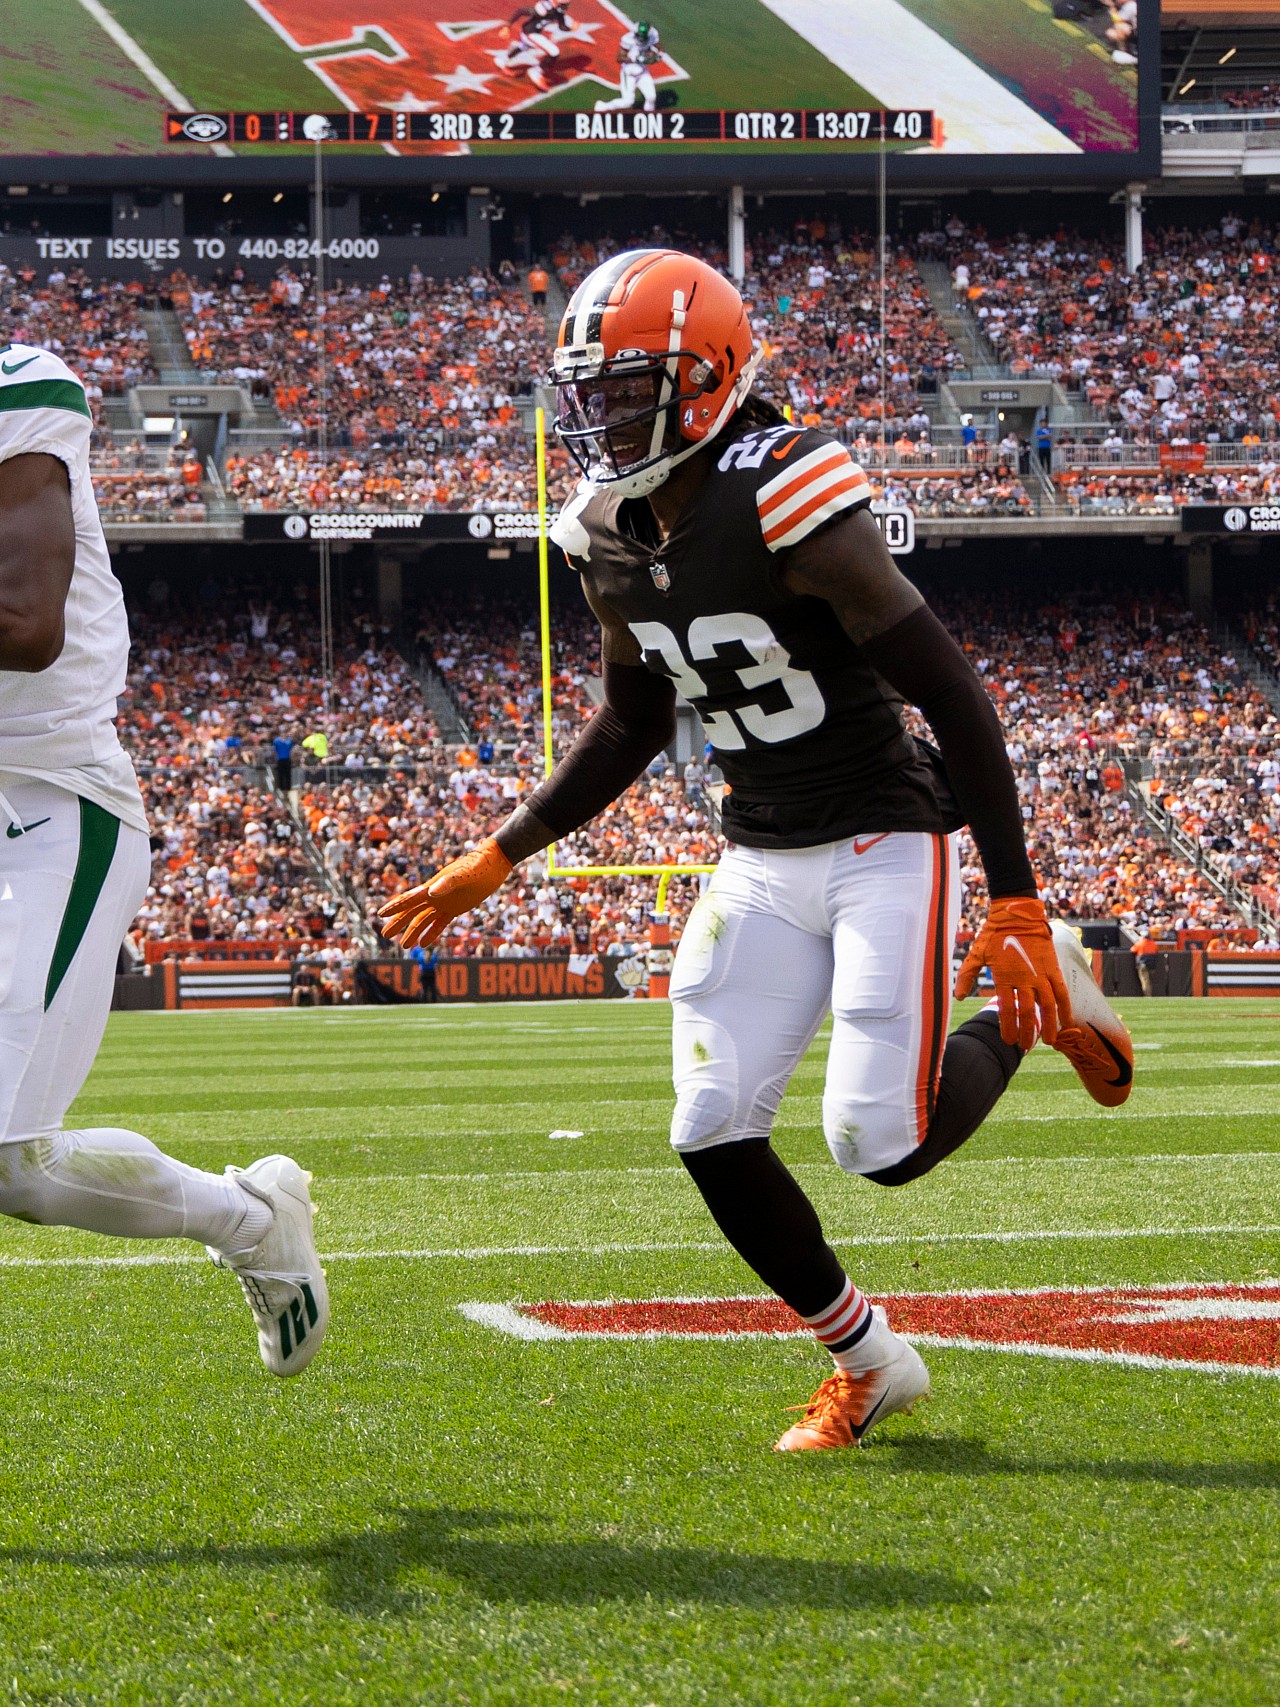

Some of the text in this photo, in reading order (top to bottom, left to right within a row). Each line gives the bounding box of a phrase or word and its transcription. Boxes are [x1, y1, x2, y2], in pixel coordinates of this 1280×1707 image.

[245, 115, 260, 139] 0
[366, 116, 379, 138] 7
[429, 114, 514, 140] 3RD & 2
[575, 113, 685, 139] BALL ON 2
[734, 113, 795, 140] QTR 2
[815, 113, 871, 138] 13:07
[893, 113, 922, 138] 40
[36, 238, 380, 260] TEXT ISSUES TO 440-824-6000
[309, 514, 424, 528] CROSSCOUNTRY
[310, 528, 372, 539] MORTGAGE
[628, 612, 826, 751] 23
